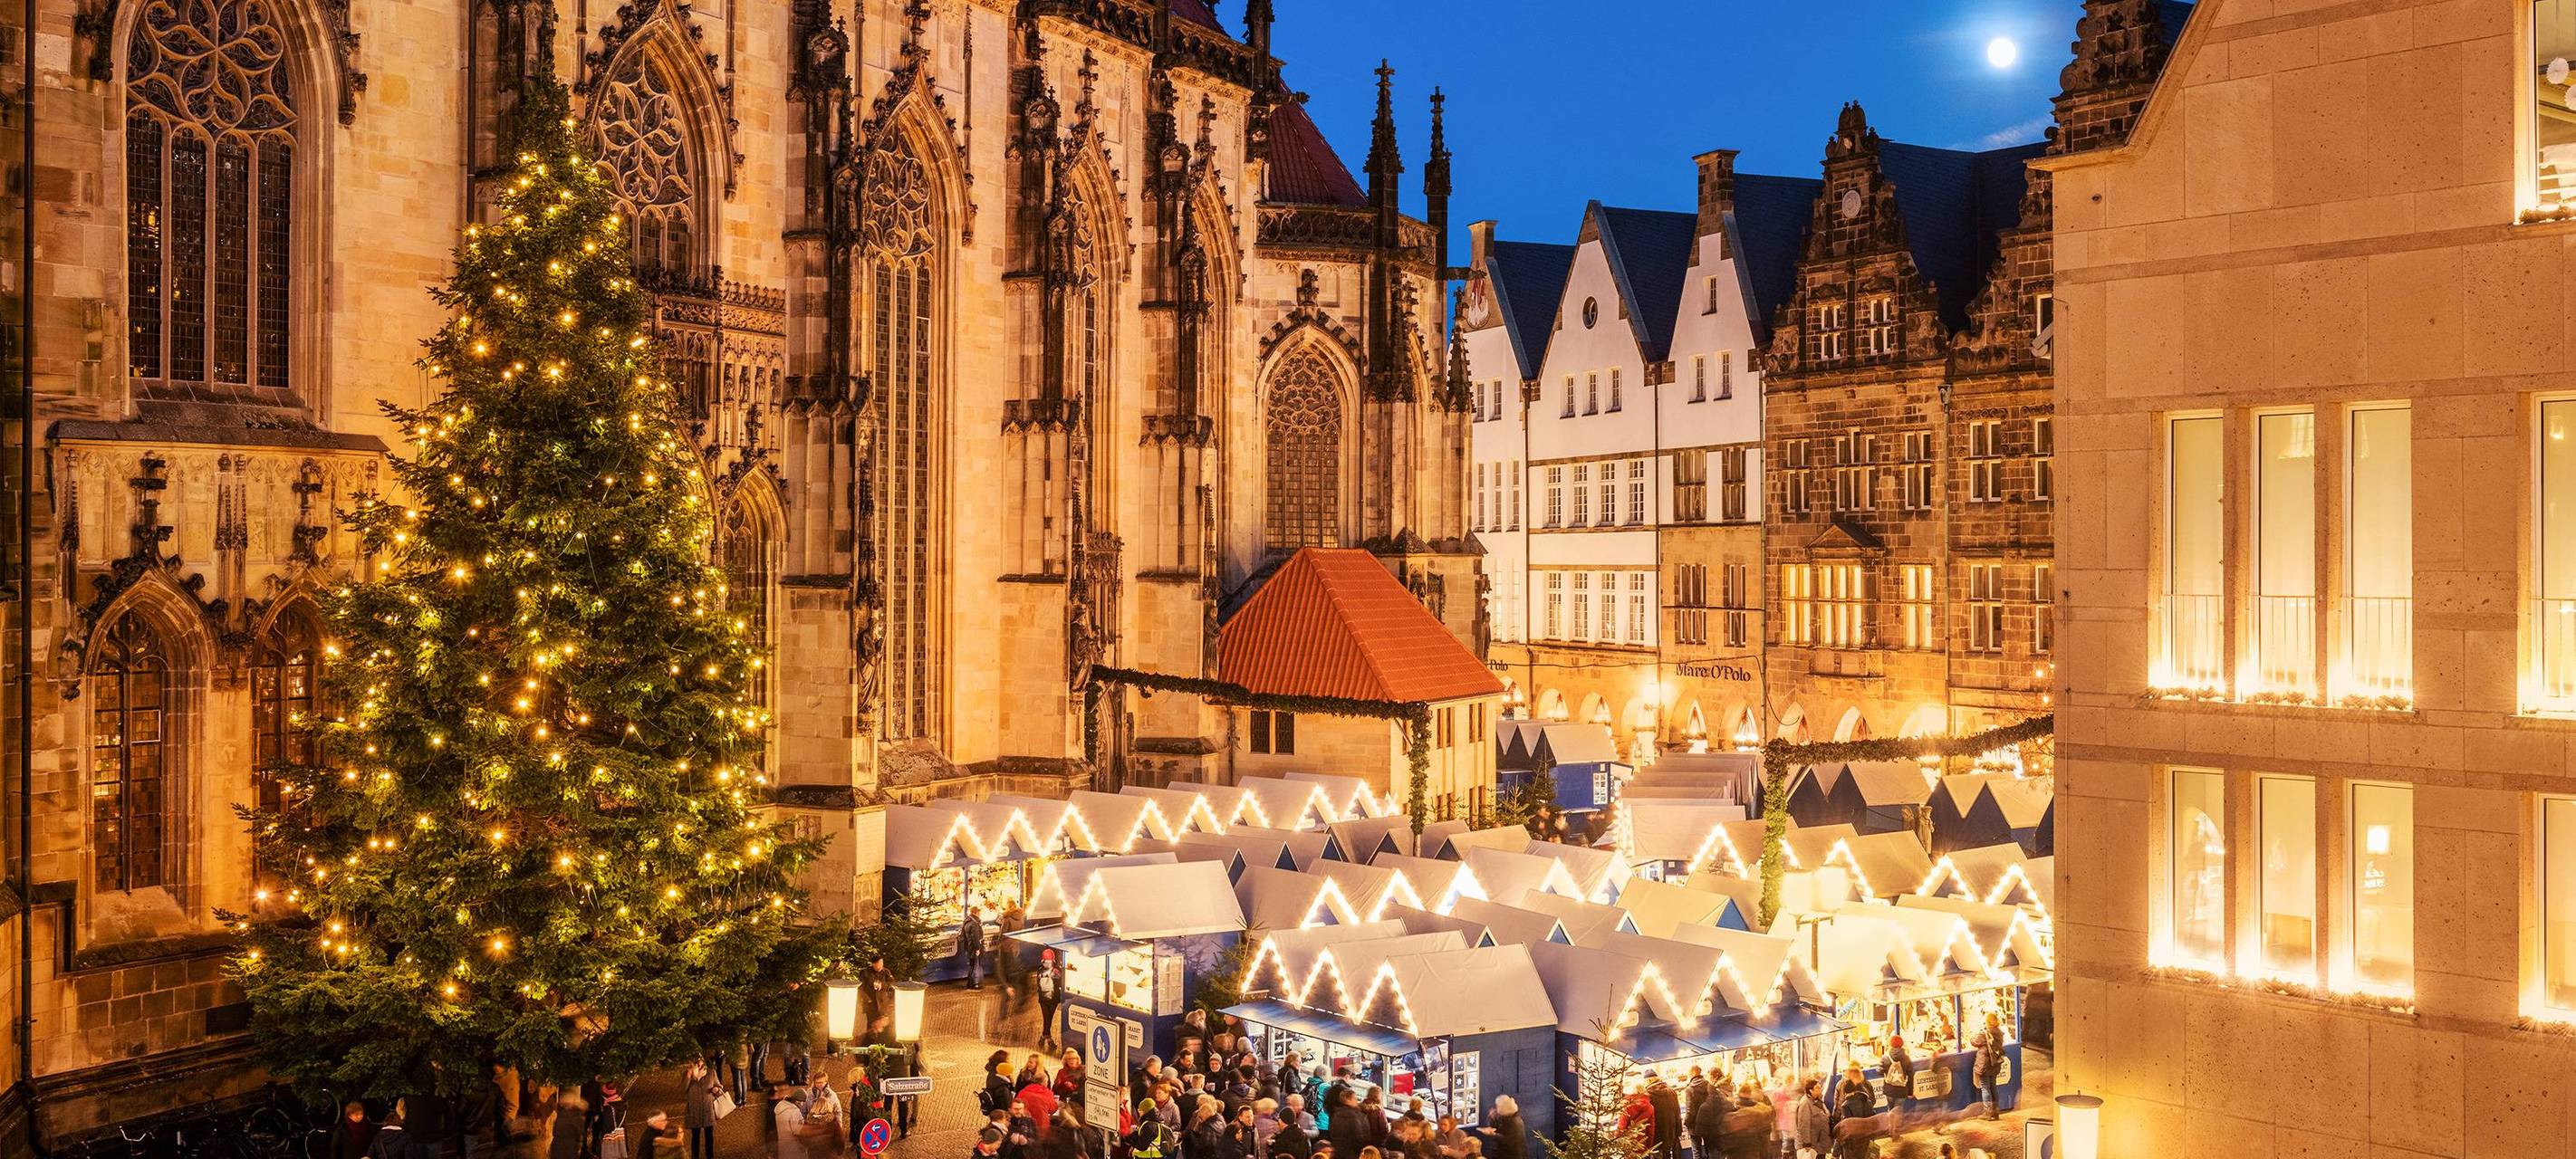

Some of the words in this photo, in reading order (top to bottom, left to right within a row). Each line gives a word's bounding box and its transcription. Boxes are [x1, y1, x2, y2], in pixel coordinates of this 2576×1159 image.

[1676, 663, 1707, 677] Marc
[1711, 665, 1752, 682] O'Polo
[1093, 1064, 1109, 1079] ZONE
[888, 1081, 928, 1090] Salzstraße
